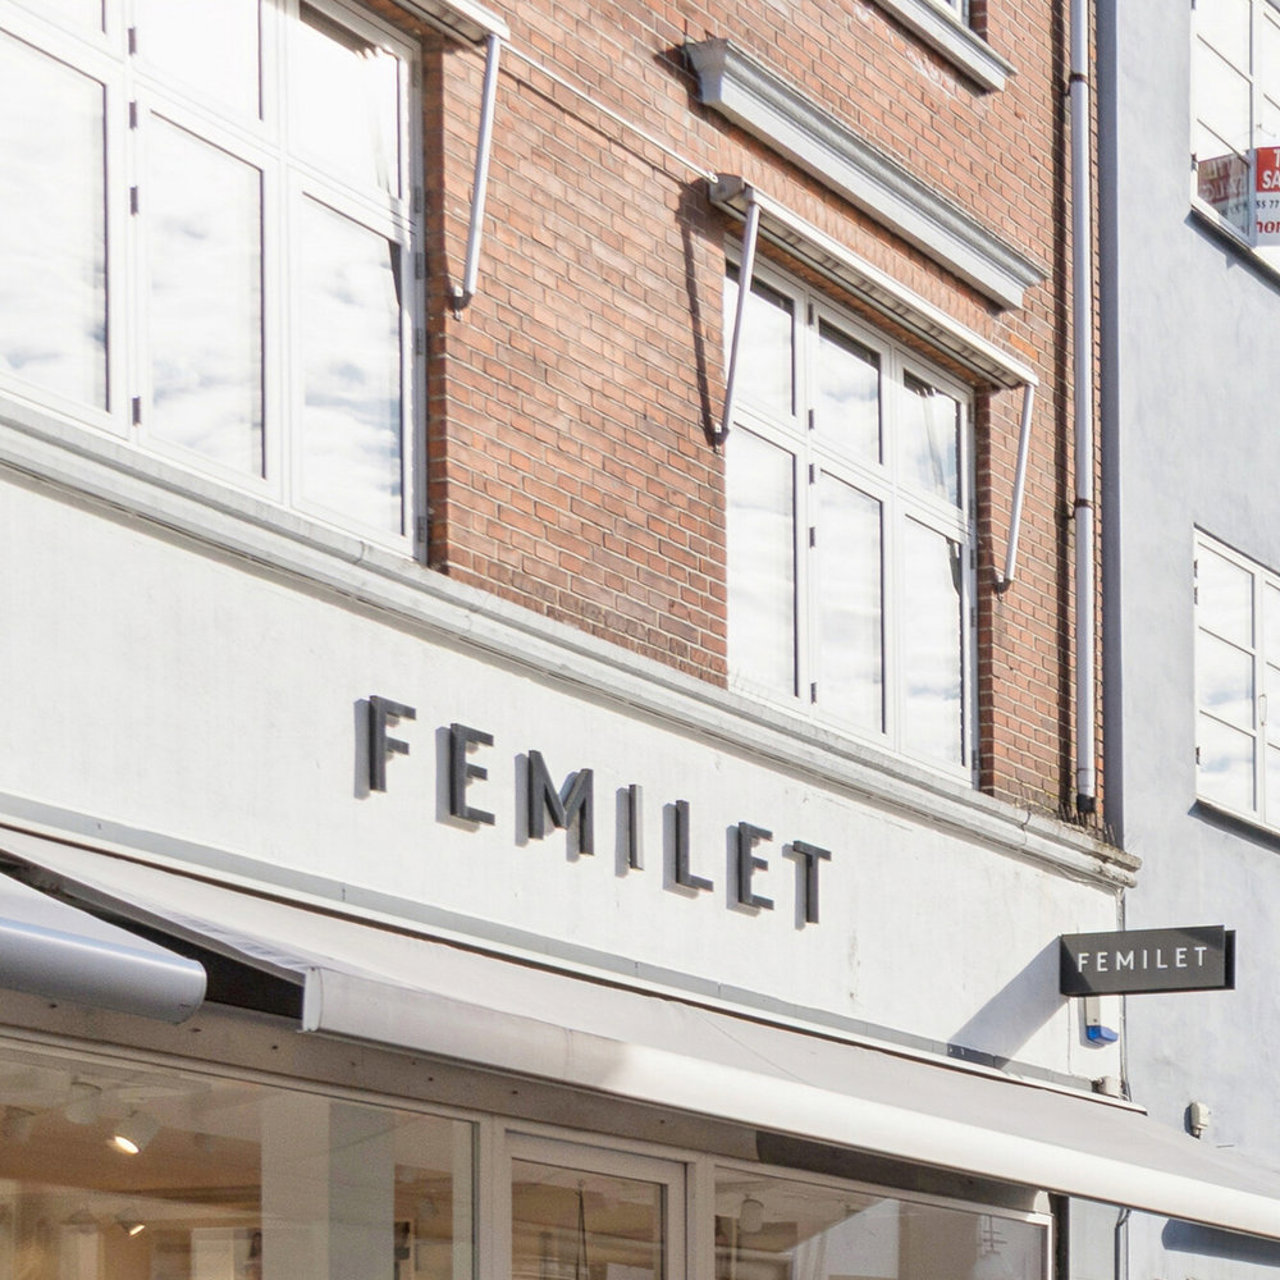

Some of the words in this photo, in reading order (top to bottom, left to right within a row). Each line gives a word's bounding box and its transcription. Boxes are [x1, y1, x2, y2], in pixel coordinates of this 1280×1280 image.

[1269, 200, 1280, 208] 77
[366, 695, 832, 926] FEMILET
[1078, 947, 1207, 973] FEMILET
